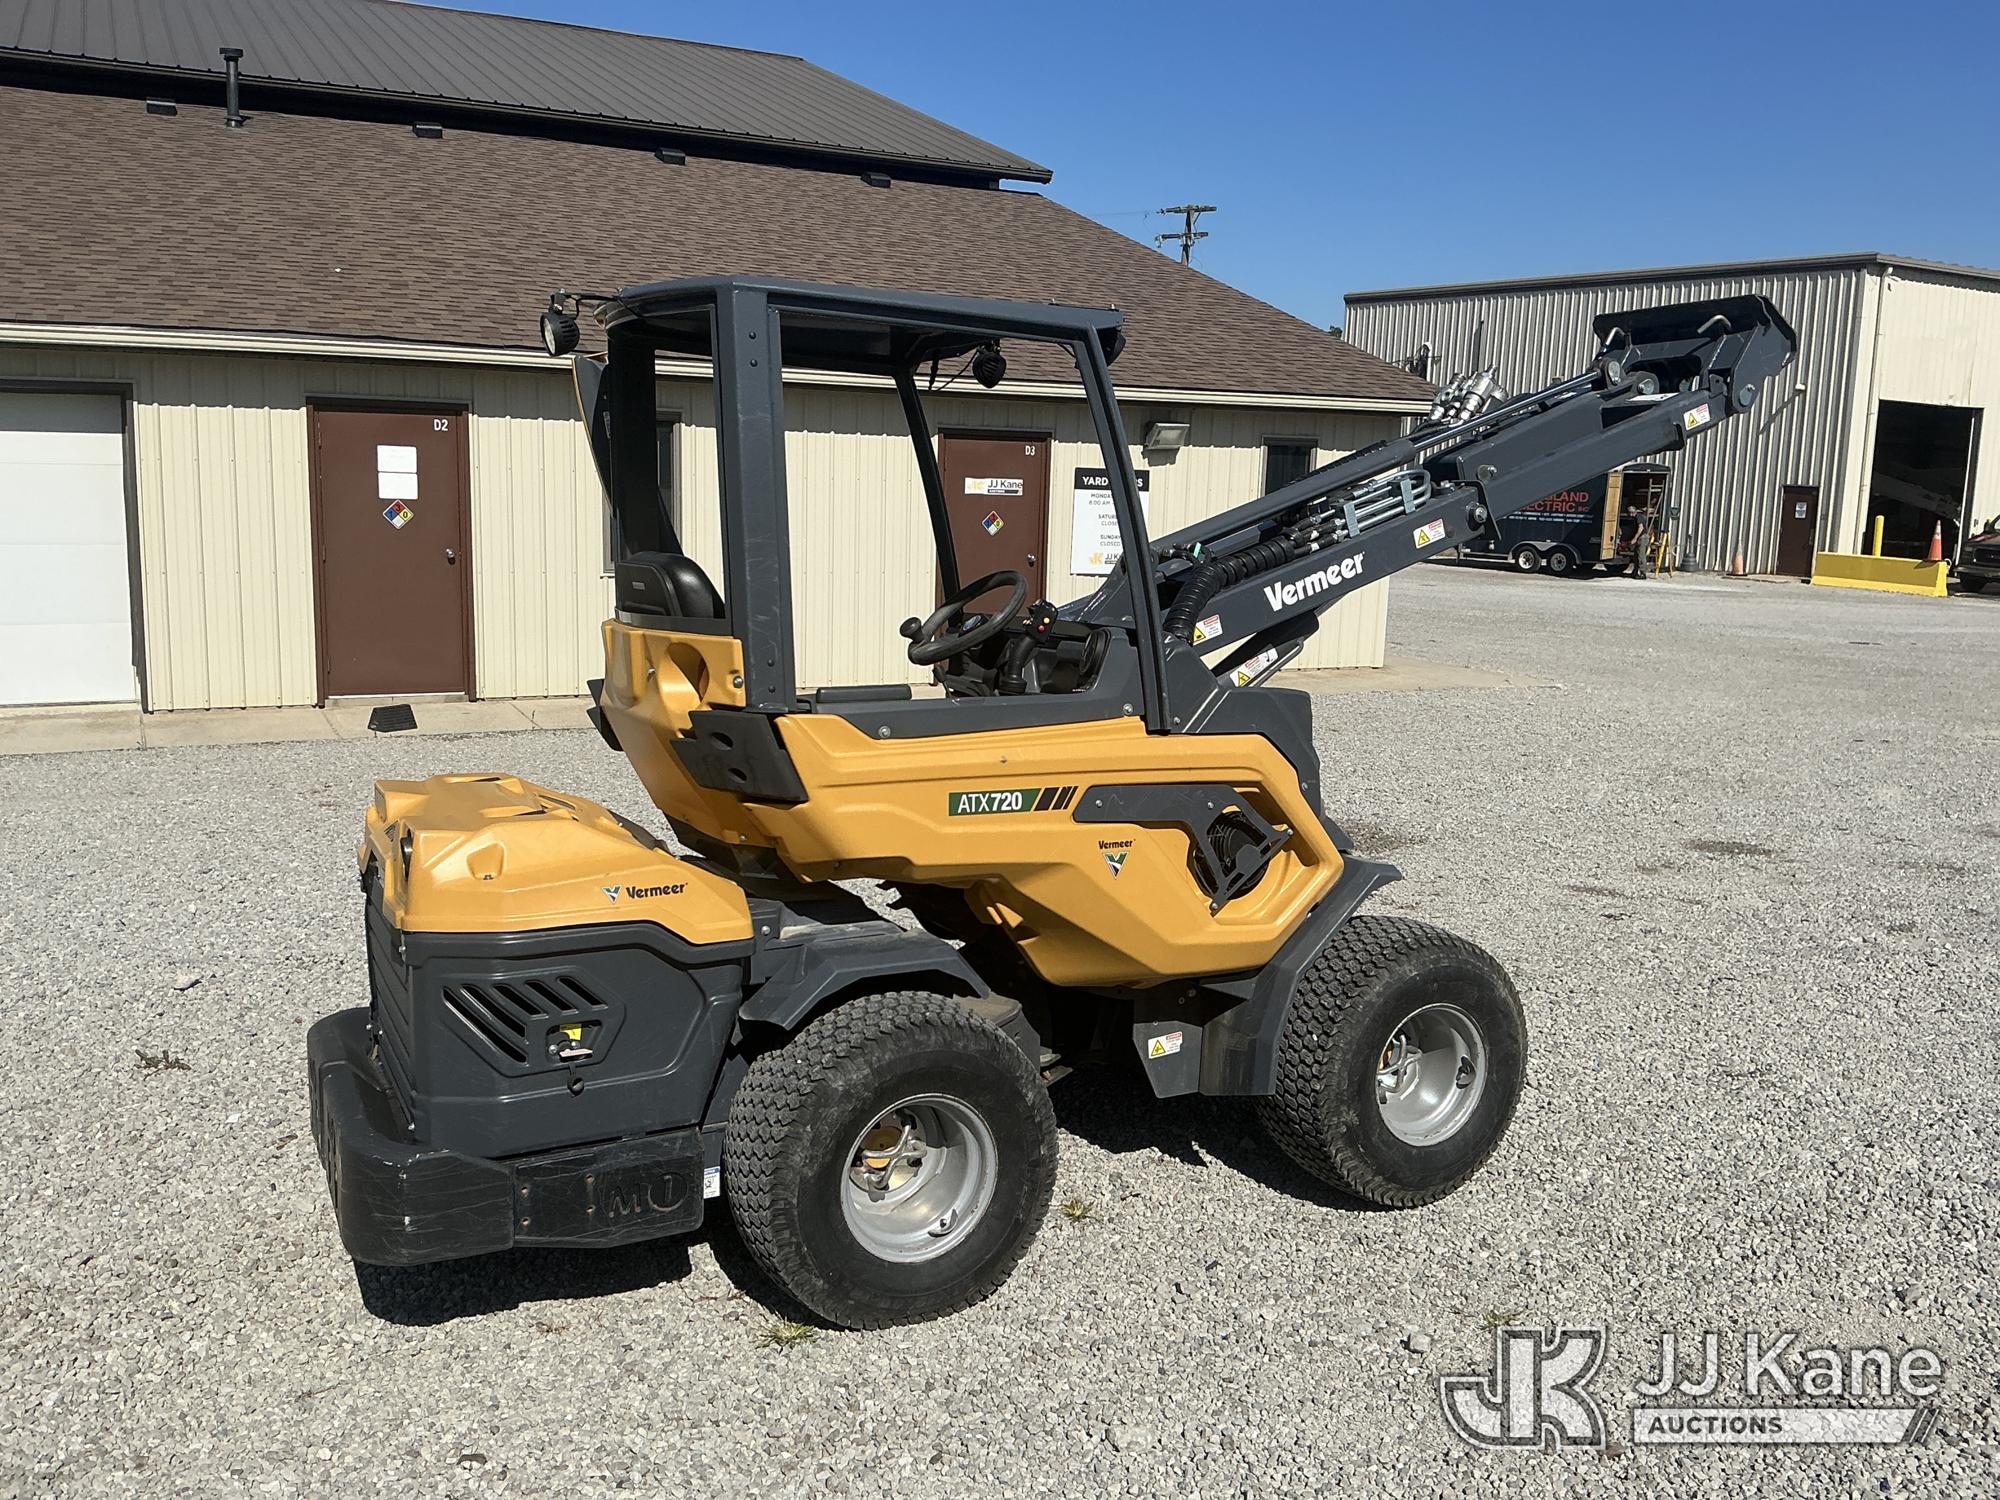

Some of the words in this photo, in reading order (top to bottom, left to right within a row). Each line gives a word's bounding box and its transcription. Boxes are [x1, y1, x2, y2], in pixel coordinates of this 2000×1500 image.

[433, 418, 448, 431] D2
[1025, 445, 1035, 455] D3
[1000, 479, 1023, 489] Kane
[1082, 476, 1109, 486] YARD
[1263, 552, 1364, 612] Vermeer
[957, 791, 1023, 813] ATX720
[1098, 839, 1133, 850] Vermeer
[625, 883, 686, 899] Vermeer
